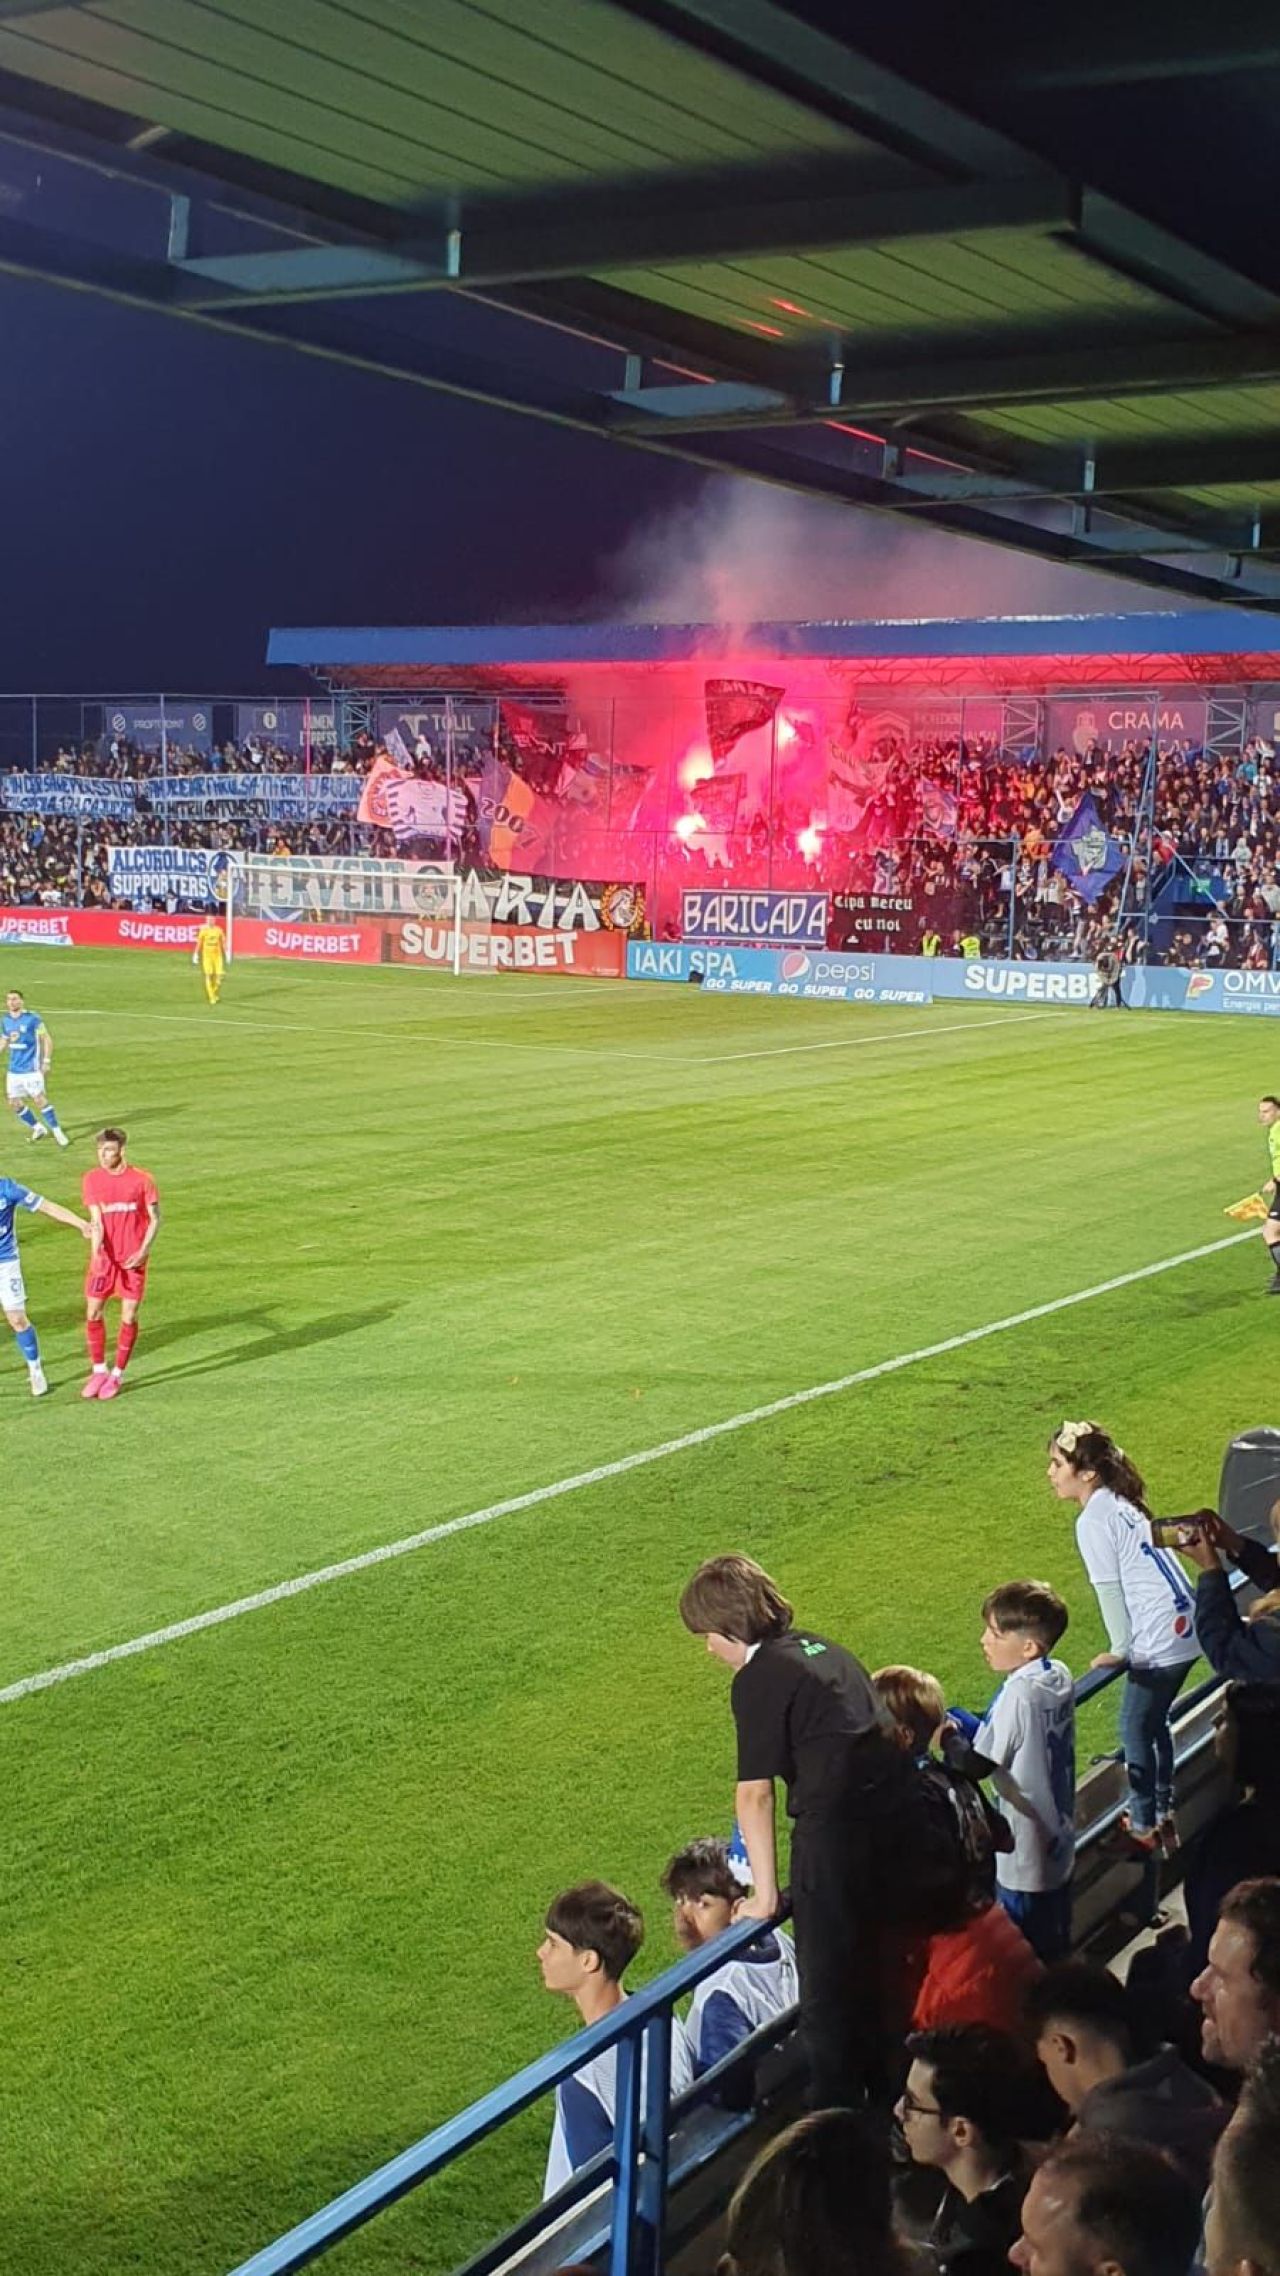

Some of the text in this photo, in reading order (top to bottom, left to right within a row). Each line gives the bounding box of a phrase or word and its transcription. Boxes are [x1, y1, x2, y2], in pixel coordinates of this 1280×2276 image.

[1108, 711, 1184, 729] CRAMA
[113, 848, 207, 872] ALCOHOLICS
[113, 874, 208, 897] SUPPORTERS
[684, 895, 827, 937] BARICADA
[118, 918, 200, 943] SUPERBE
[265, 927, 361, 954] SUPERBET
[400, 922, 579, 968] SUPERBET
[635, 949, 737, 977] IAKI SPA
[815, 960, 875, 983] pepsi
[706, 977, 926, 1003] GO SUPER GO SUPER GO SUPER
